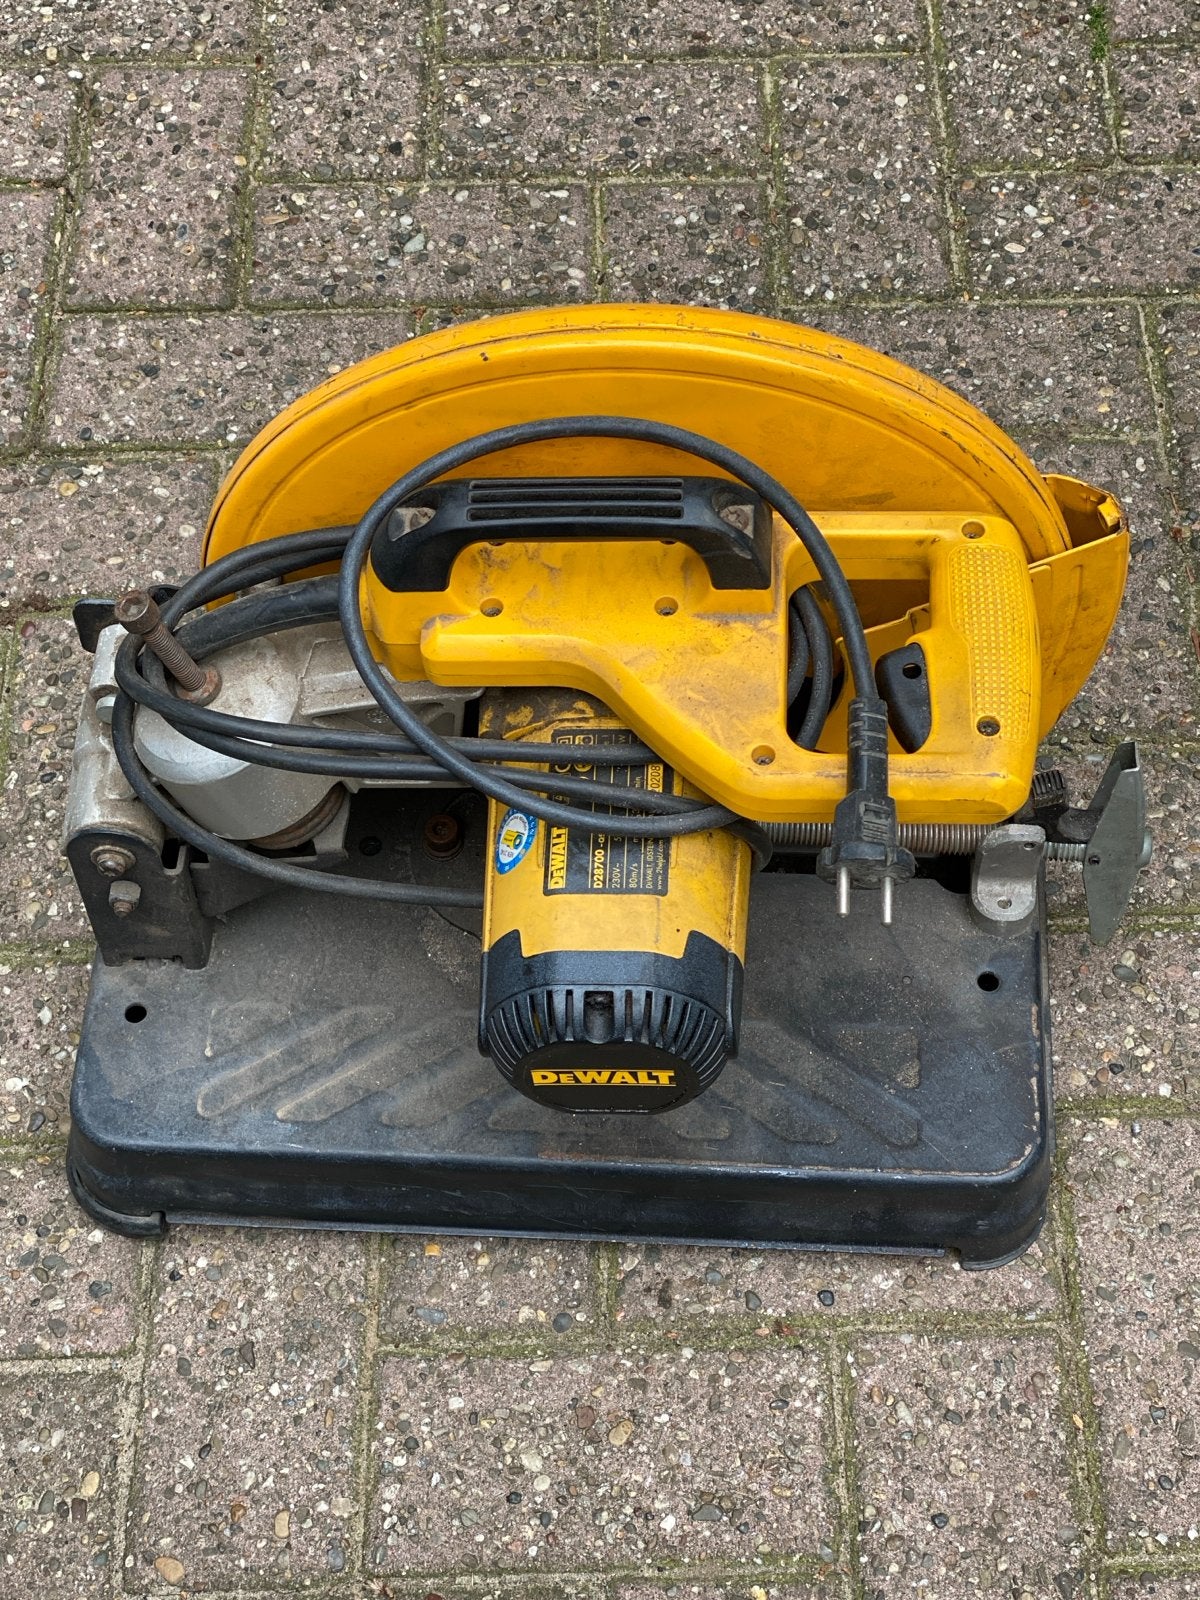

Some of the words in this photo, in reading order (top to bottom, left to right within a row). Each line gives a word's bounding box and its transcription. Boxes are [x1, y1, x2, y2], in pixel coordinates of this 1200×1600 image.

[549, 827, 567, 889] DEWALT
[593, 849, 605, 889] D28700
[629, 862, 638, 888] 80m/s
[531, 1070, 675, 1085] DEWALT
